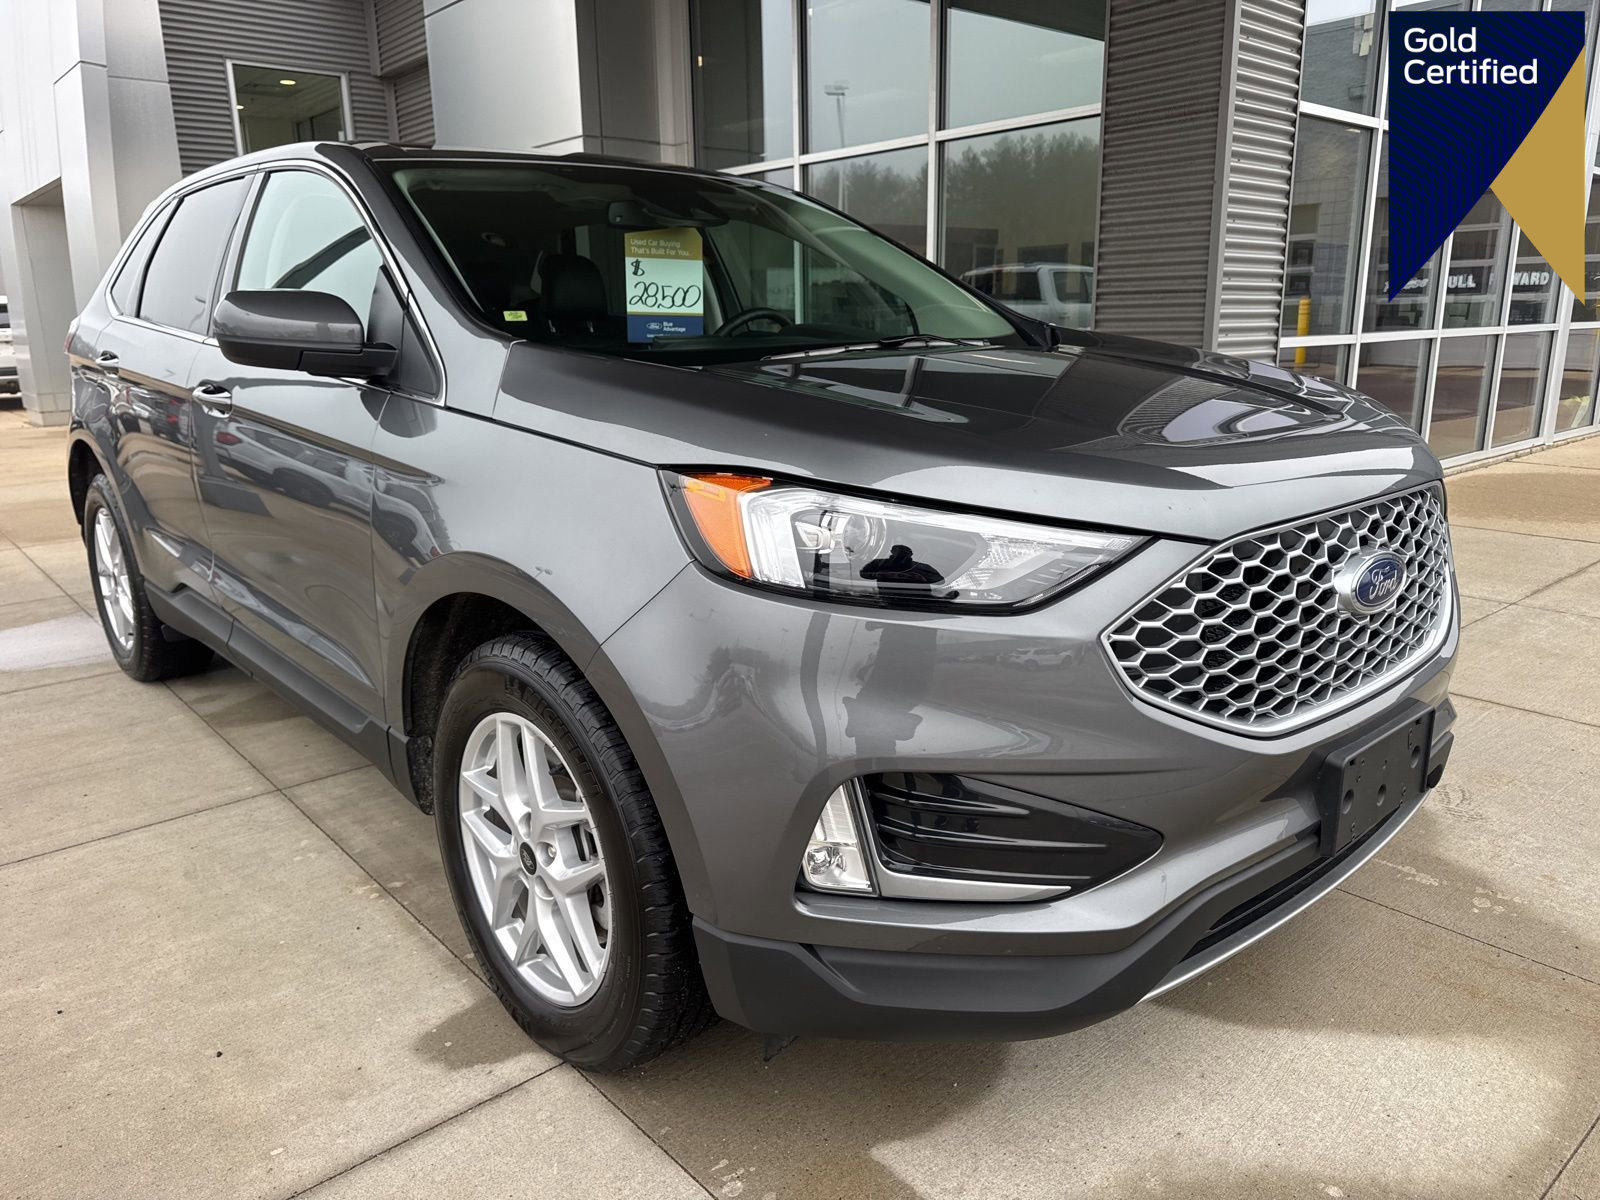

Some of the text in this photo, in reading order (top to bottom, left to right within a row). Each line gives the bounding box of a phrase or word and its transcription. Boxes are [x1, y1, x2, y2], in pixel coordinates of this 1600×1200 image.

[631, 246, 650, 254] That's
[651, 247, 666, 255] Built
[667, 248, 676, 256] For
[659, 239, 681, 248] Buying
[630, 259, 645, 276] $
[1447, 273, 1476, 289] ULL
[1368, 565, 1398, 600] Ford
